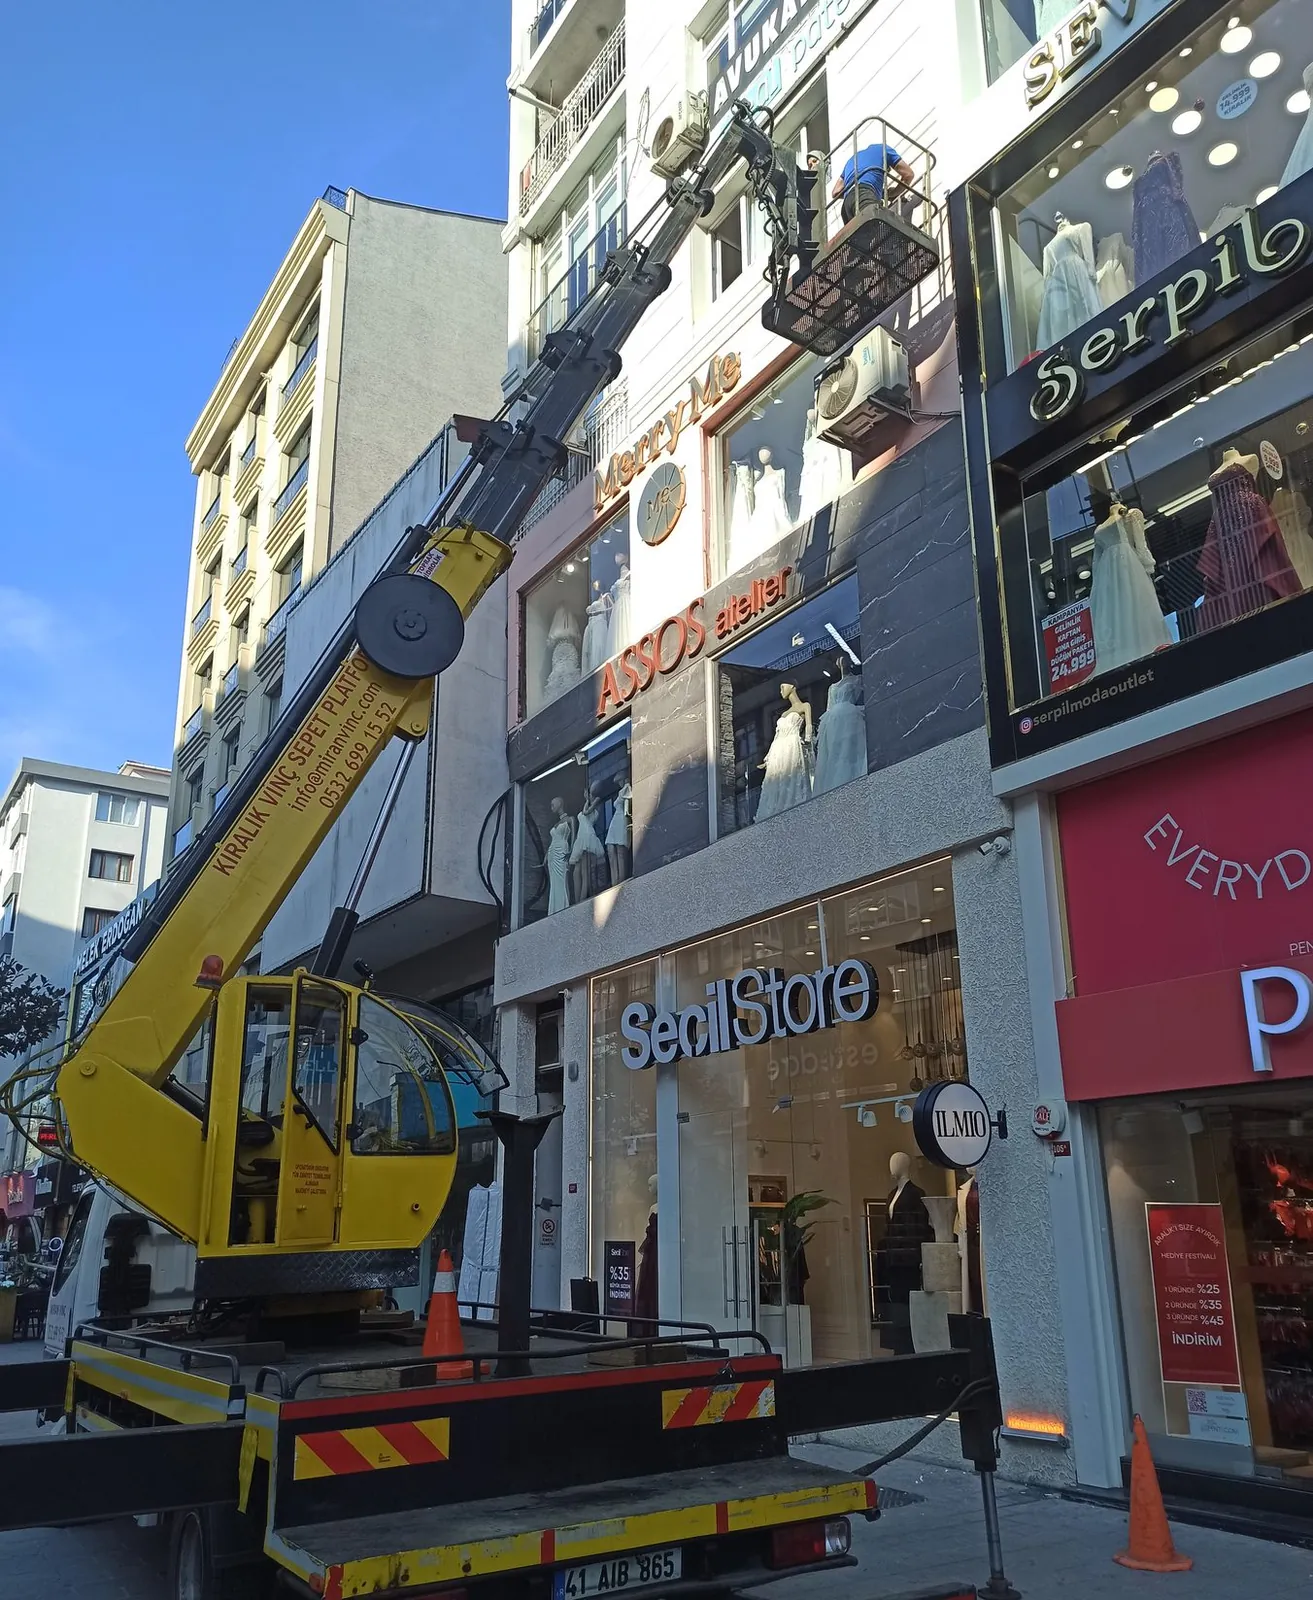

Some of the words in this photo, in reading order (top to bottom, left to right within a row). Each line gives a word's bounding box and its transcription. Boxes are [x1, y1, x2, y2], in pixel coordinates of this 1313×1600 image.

[713, 0, 808, 117] AVUKA
[1029, 208, 1308, 422] Serpil
[593, 400, 685, 514] Merry
[688, 351, 742, 426] Me
[1047, 603, 1084, 626] KAMPANYA
[1057, 626, 1081, 643] KAFTAN
[595, 597, 705, 718] ASSOS
[714, 566, 792, 639] atelier
[1051, 648, 1096, 682] 24.999
[1032, 668, 1155, 727] serpilmodaoutlet
[288, 713, 331, 767] SEPET
[288, 681, 383, 812] info@miranvinc.com
[319, 771, 352, 809] 0532
[344, 742, 369, 772] 699
[364, 720, 384, 741] 15
[375, 701, 397, 723] 52
[621, 958, 876, 1070] SecilStore
[935, 1110, 986, 1138] ILMIO
[609, 1266, 629, 1281] %35
[1196, 1283, 1220, 1295] %25
[1199, 1299, 1223, 1310] %35
[1200, 1315, 1224, 1326] %45
[1171, 1330, 1222, 1347] İNDİRİM
[566, 1568, 586, 1597] 41
[598, 1560, 629, 1592] AIB
[637, 1551, 674, 1583] 865
